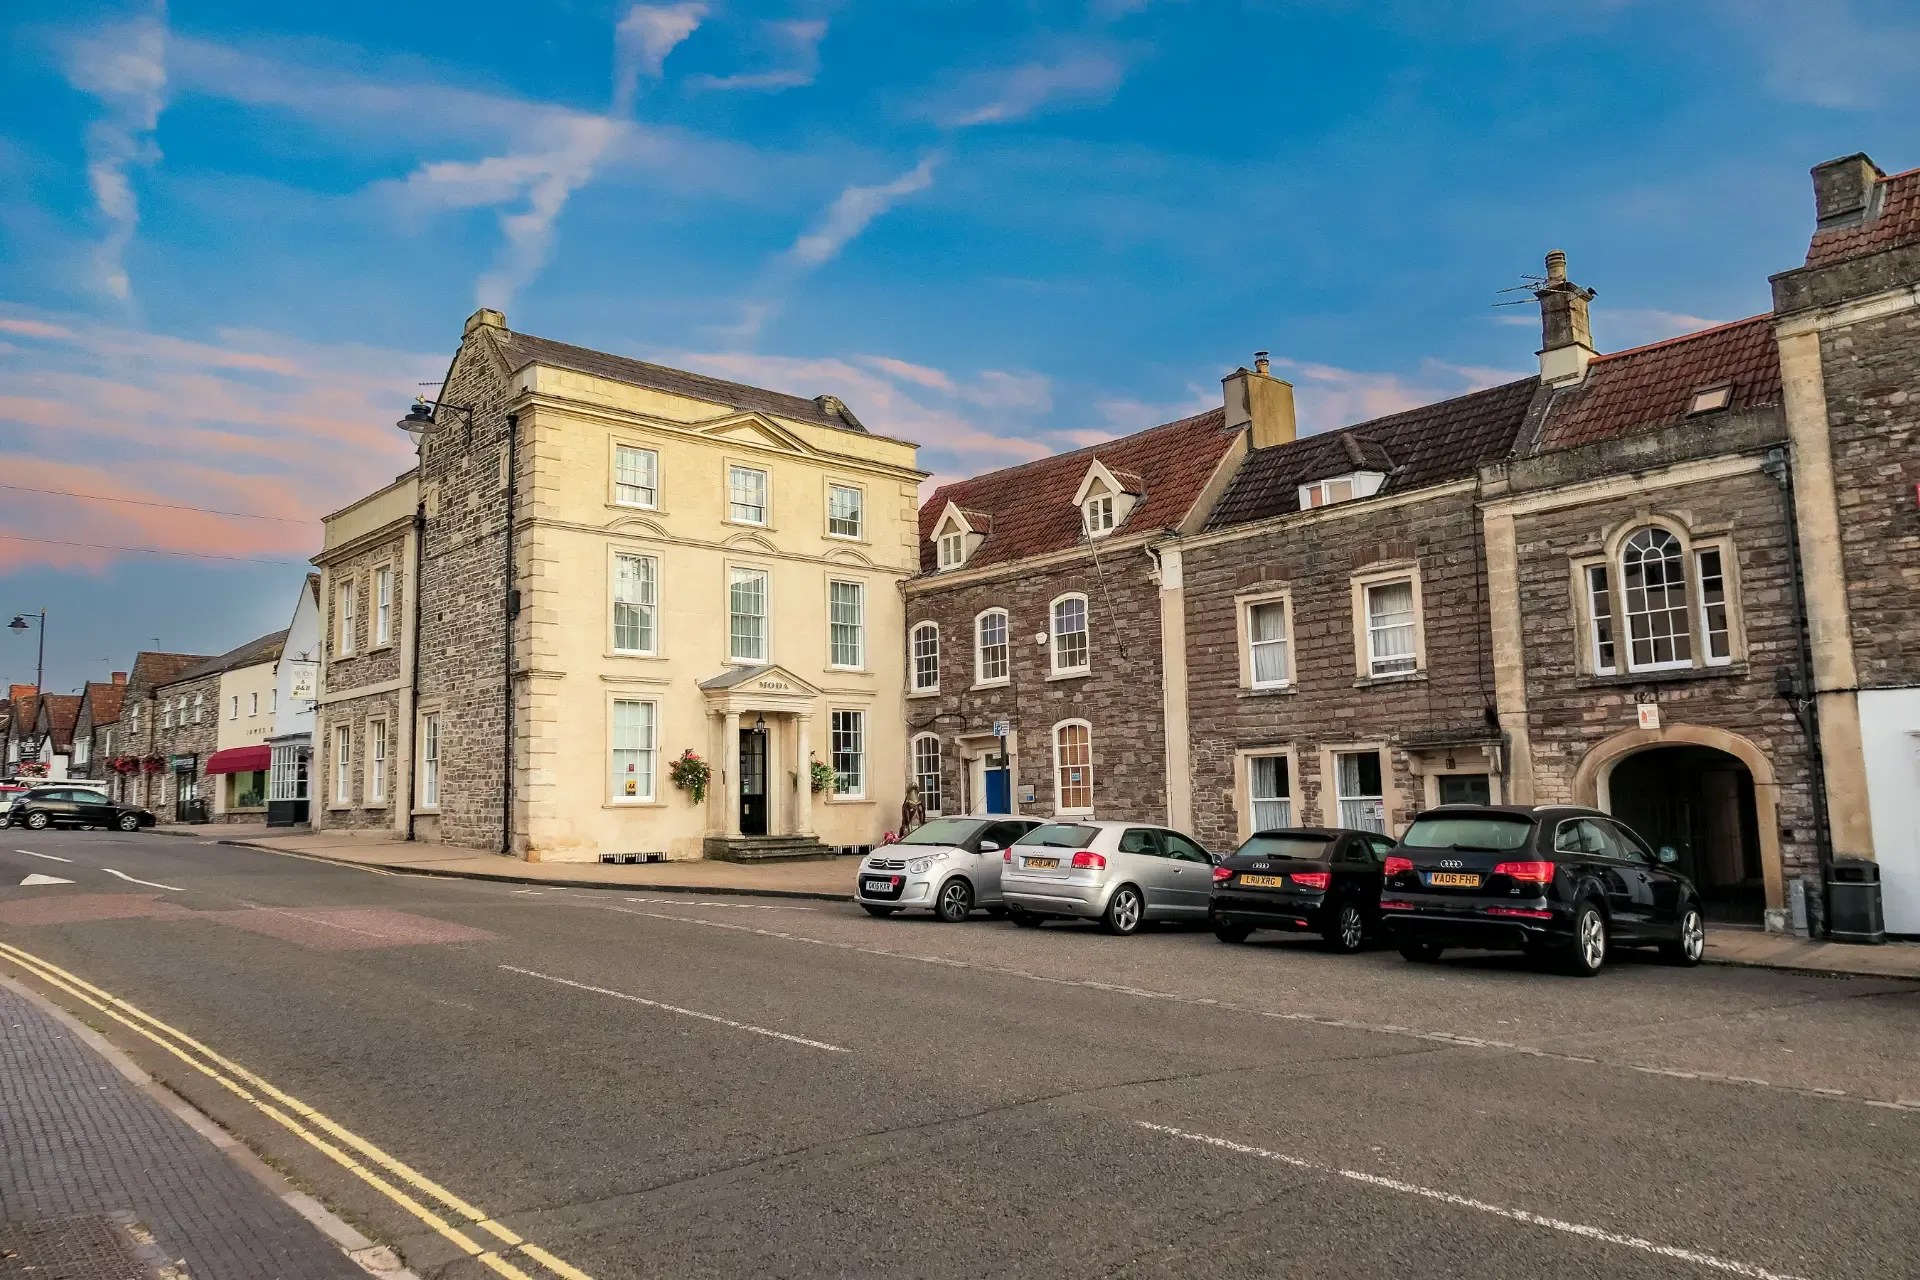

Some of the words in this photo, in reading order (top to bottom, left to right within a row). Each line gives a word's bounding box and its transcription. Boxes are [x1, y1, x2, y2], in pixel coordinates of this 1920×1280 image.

[759, 681, 789, 690] MODA
[1433, 873, 1456, 883] VA06
[1459, 876, 1478, 885] FHF
